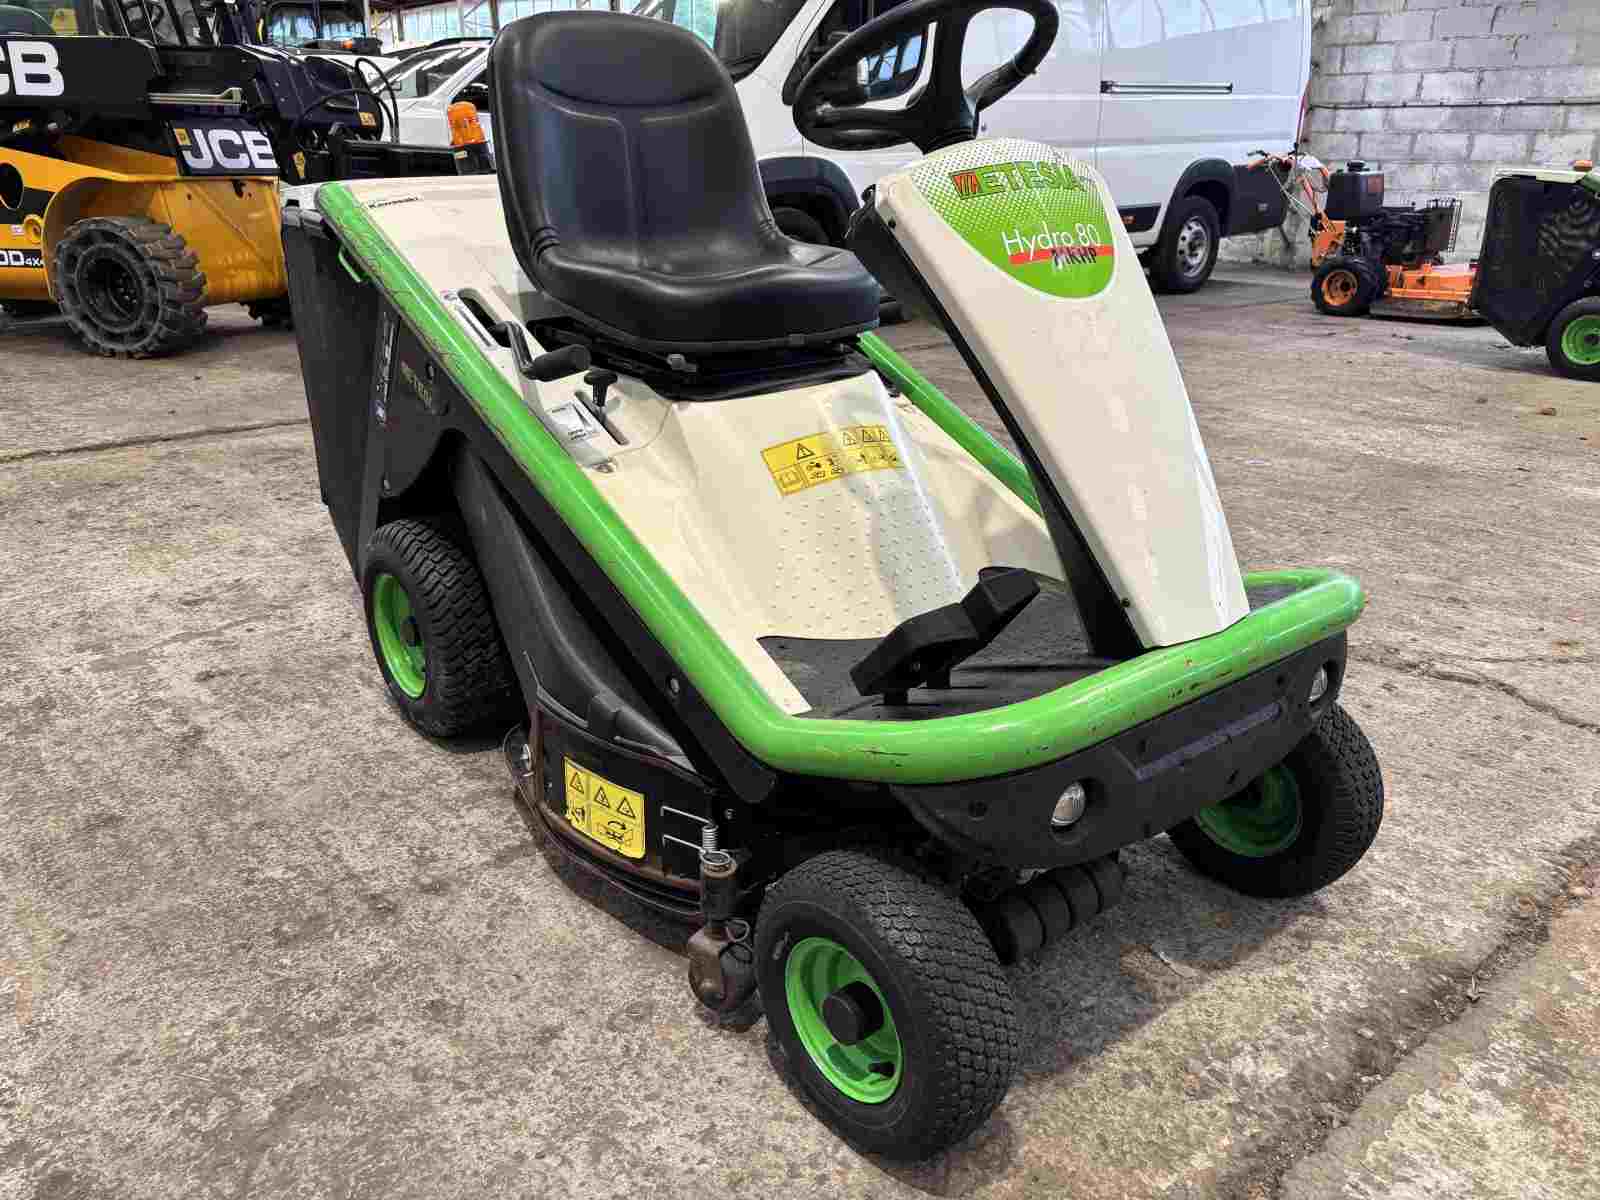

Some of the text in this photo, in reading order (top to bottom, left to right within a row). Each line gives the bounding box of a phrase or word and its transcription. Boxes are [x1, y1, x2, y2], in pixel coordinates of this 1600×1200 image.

[0, 41, 65, 97] B
[179, 128, 280, 169] JCB
[1001, 220, 1102, 262] Hydro 80
